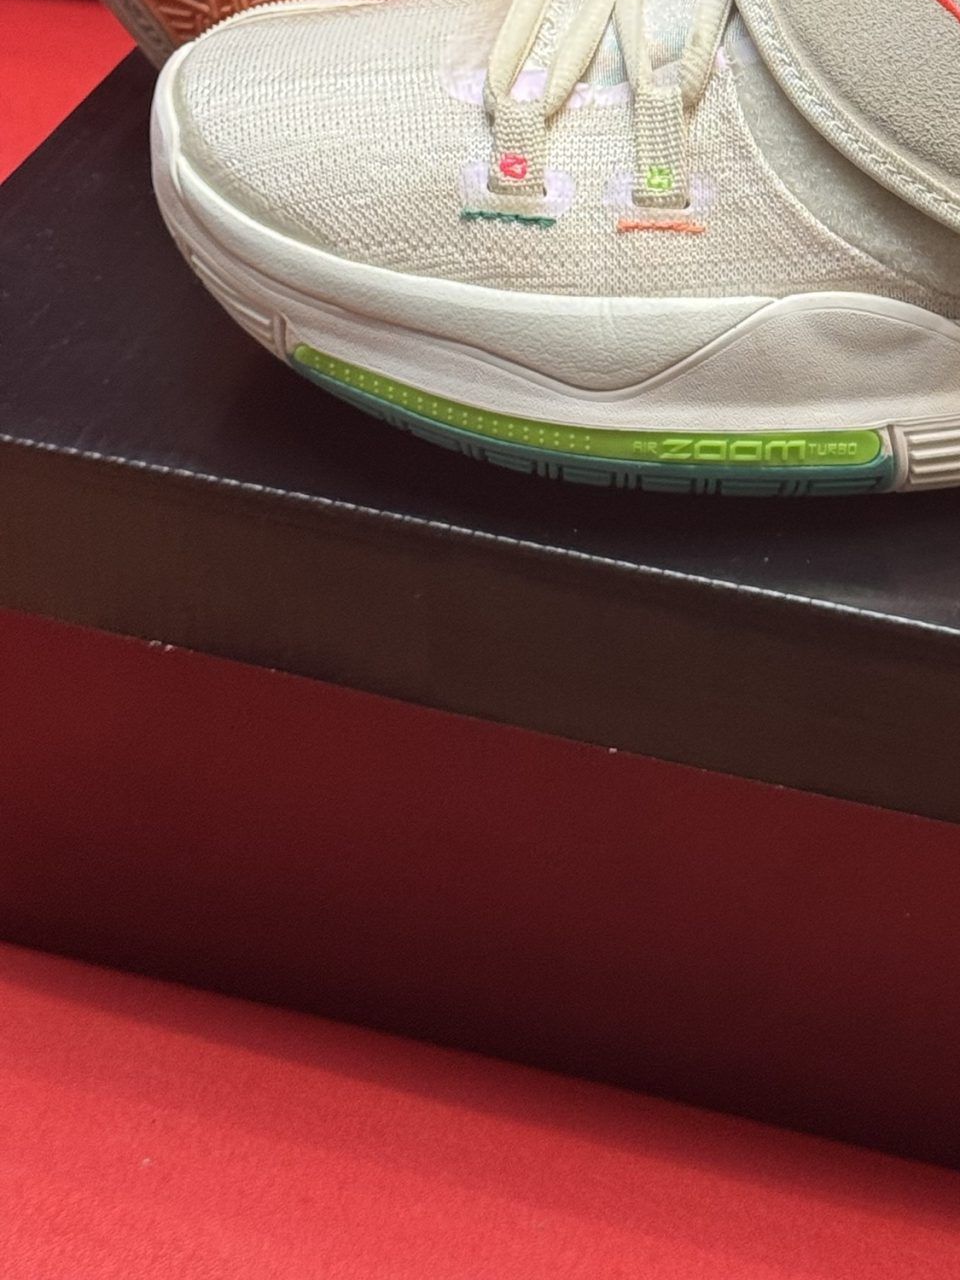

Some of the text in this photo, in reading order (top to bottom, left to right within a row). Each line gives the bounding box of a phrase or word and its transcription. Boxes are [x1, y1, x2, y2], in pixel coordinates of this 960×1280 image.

[633, 439, 857, 461] AIR ZOOM TURBO
